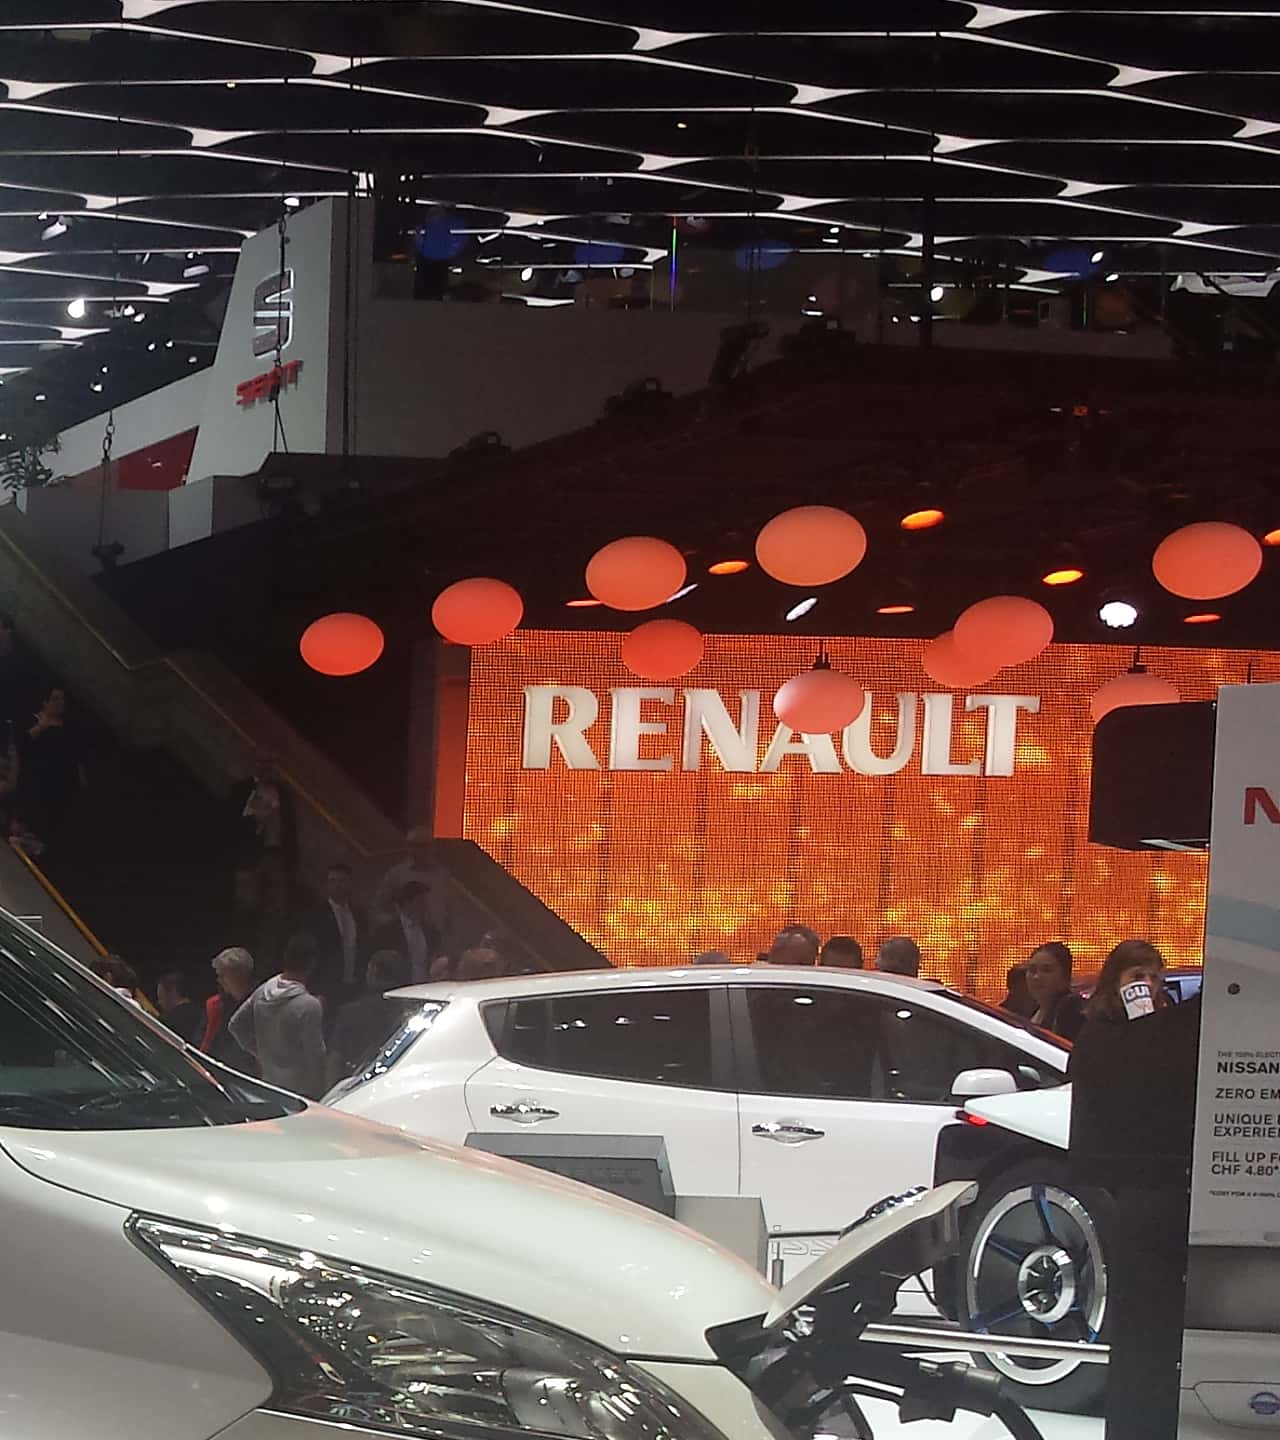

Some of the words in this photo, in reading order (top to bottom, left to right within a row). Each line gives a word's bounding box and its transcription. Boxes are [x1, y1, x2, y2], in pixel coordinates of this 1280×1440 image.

[1216, 1061, 1280, 1074] NISSAN
[1215, 1087, 1256, 1100] ZERO
[1214, 1112, 1273, 1126] UNIQUE
[1213, 1125, 1280, 1138] EXPERIE
[1212, 1151, 1240, 1163] FILL
[1245, 1151, 1267, 1163] UP
[1211, 1163, 1241, 1176] CHF
